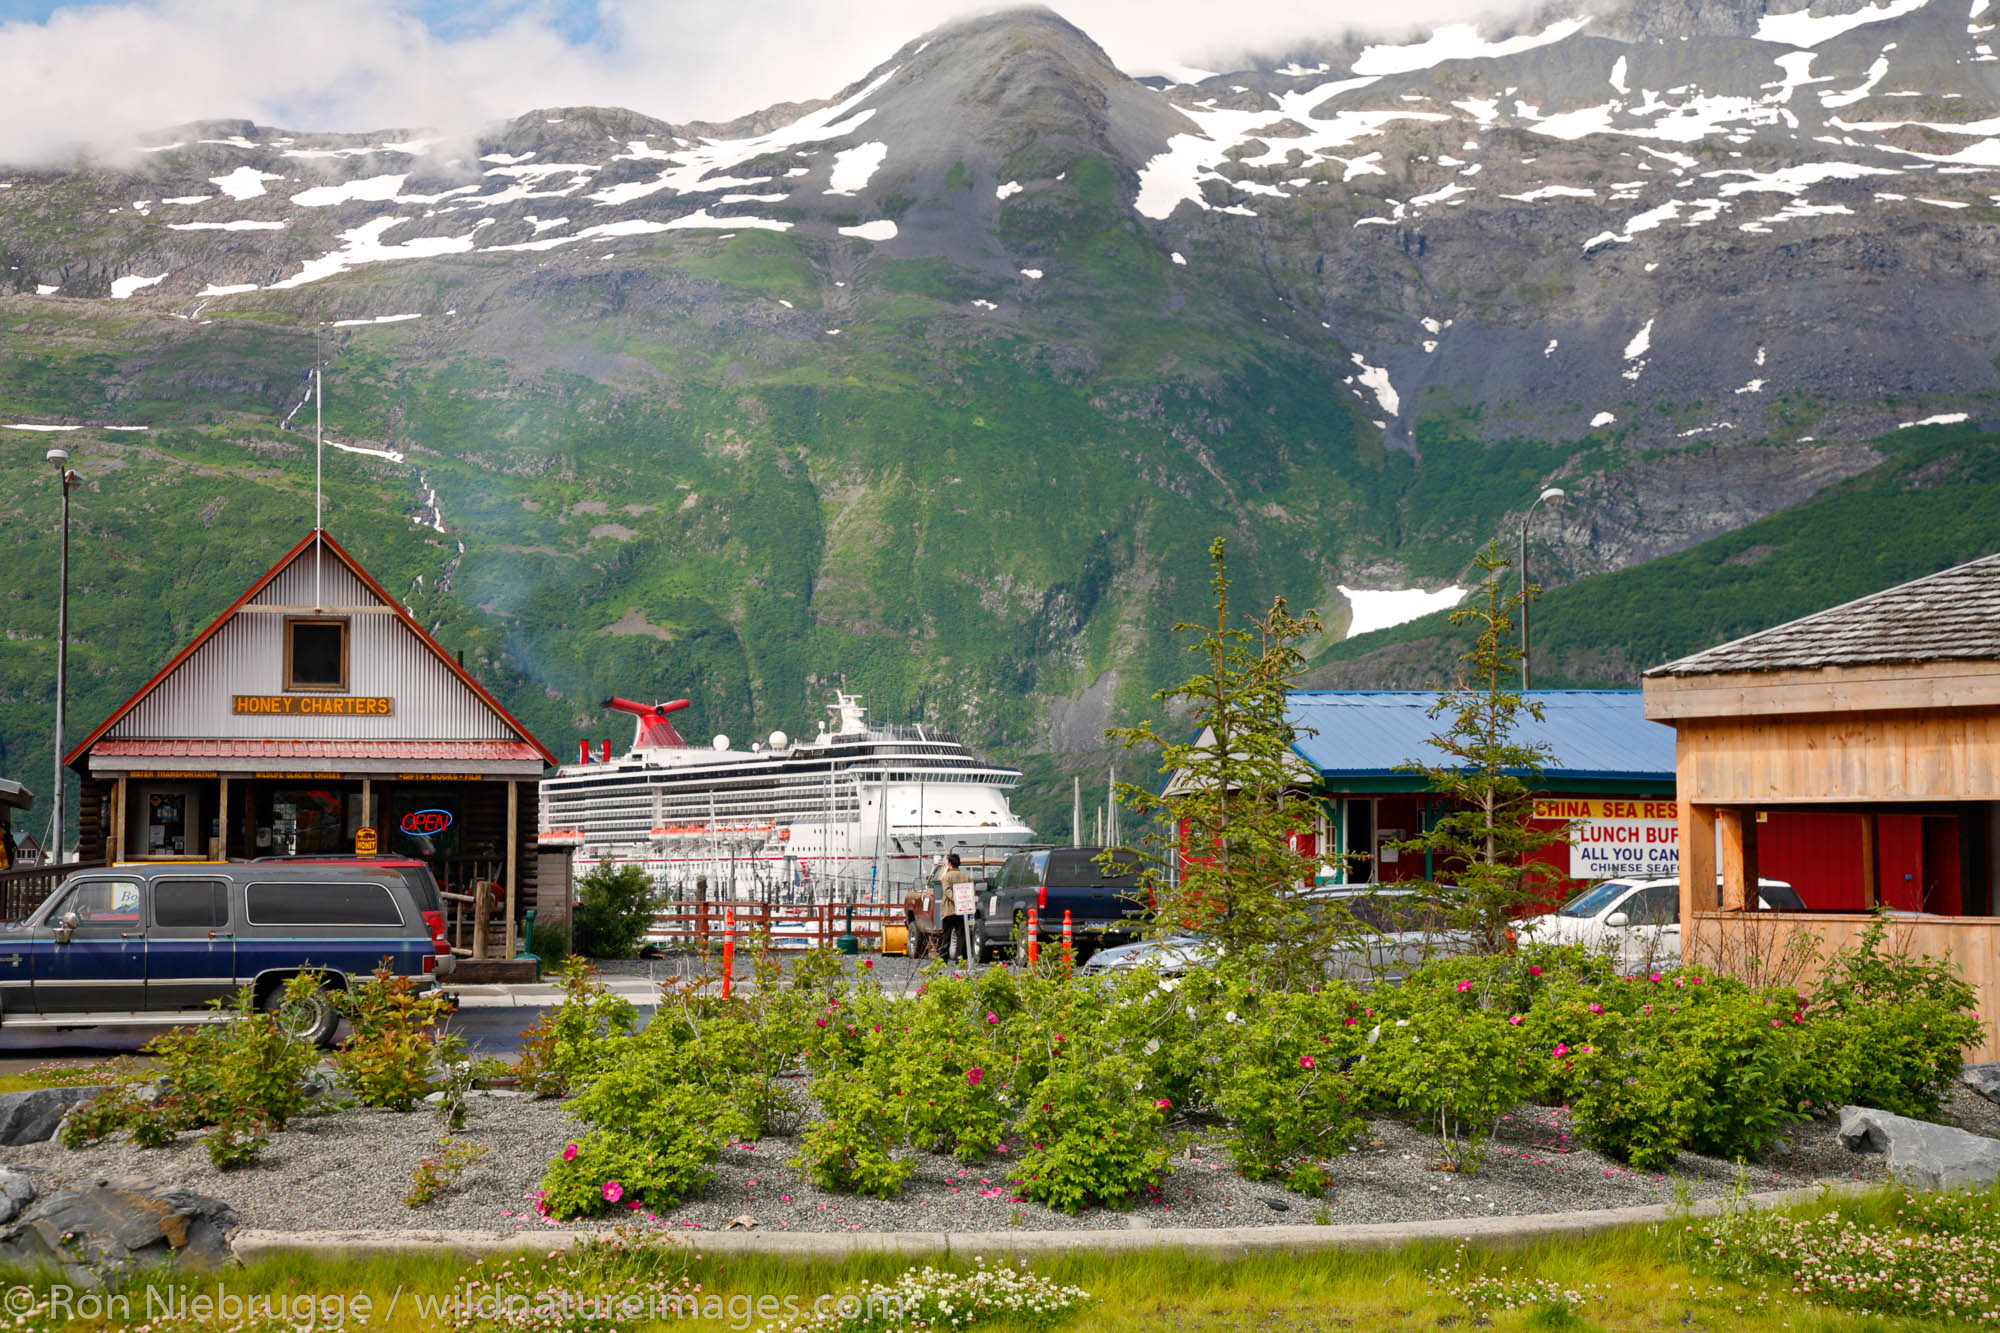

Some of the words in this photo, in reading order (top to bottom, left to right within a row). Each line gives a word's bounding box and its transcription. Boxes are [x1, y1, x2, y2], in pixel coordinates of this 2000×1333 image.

[237, 697, 292, 712] HONEY
[300, 698, 389, 713] CHARTERS
[1535, 801, 1591, 816] CHINA
[1603, 802, 1639, 818] SEA
[401, 813, 449, 831] OPEN
[1581, 827, 1639, 842] LUNCH
[1581, 848, 1608, 860] ALL
[1613, 849, 1643, 860] YOU
[1590, 863, 1642, 873] CHINESE
